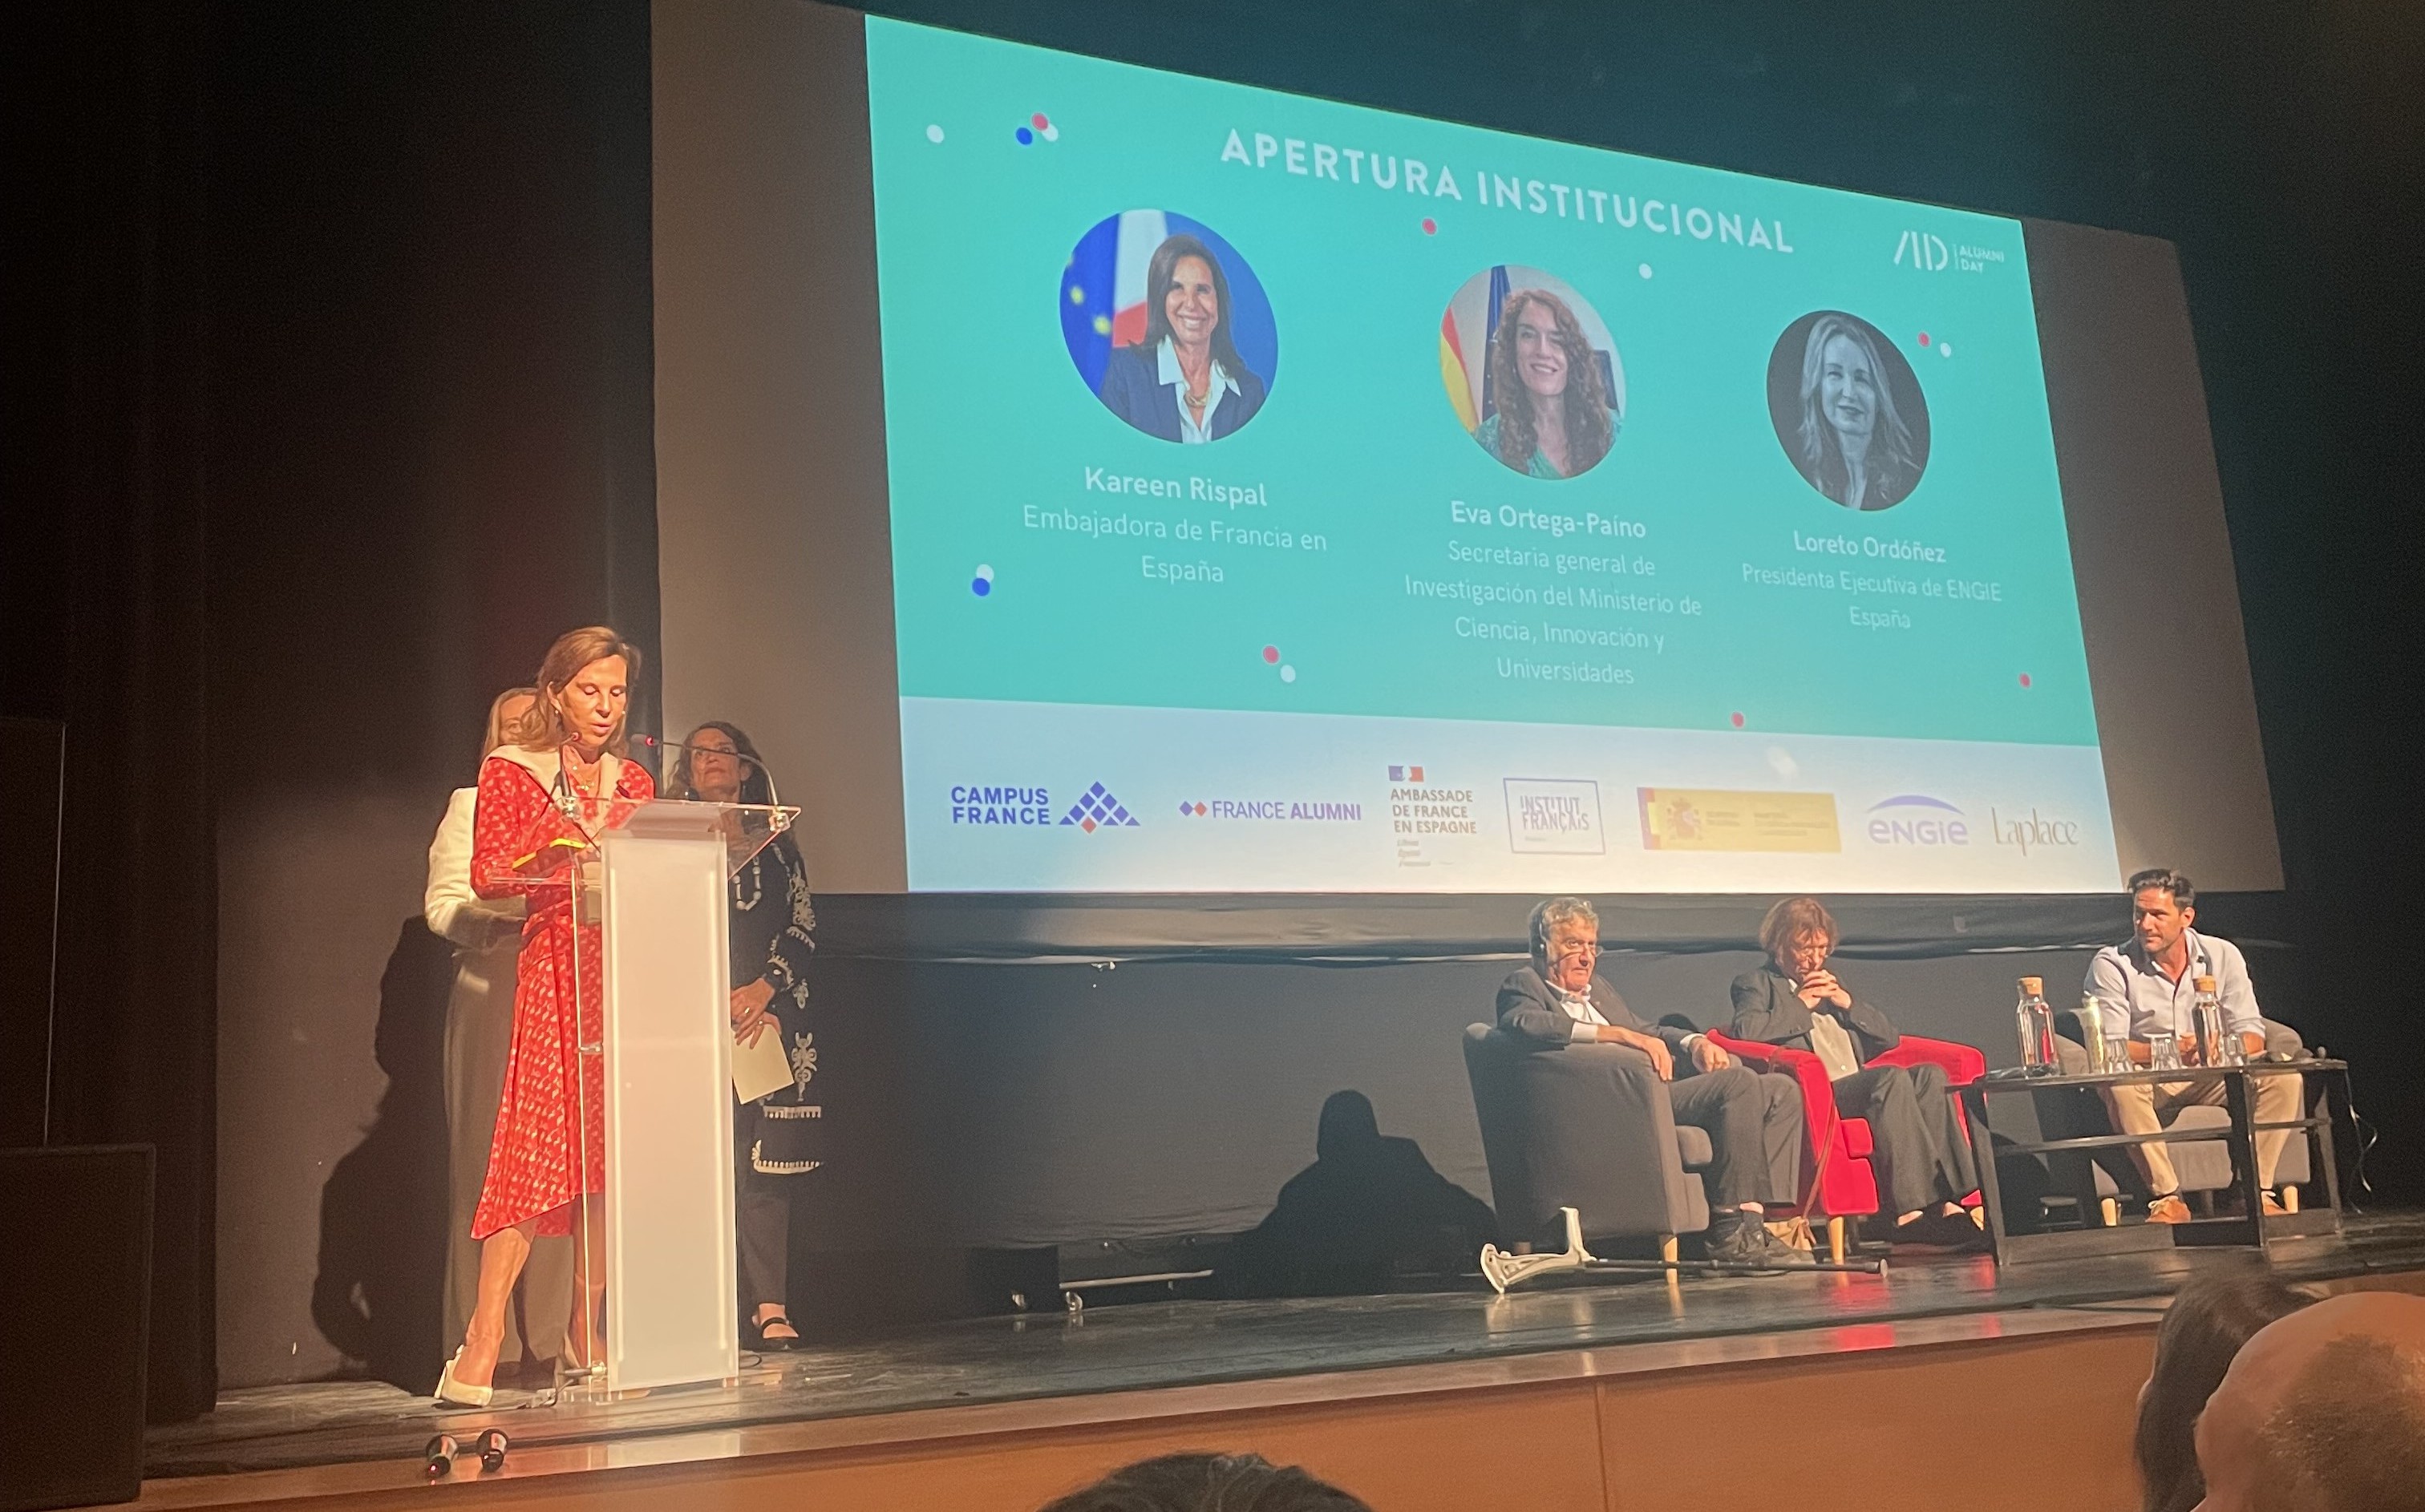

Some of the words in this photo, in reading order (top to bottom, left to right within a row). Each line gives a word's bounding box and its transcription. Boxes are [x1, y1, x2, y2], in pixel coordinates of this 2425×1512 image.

[1220, 128, 1463, 200] APERTURA
[1477, 172, 1794, 253] INSTITUCIONAL
[1960, 245, 2004, 263] ALUMNI
[1961, 258, 1983, 273] DAY
[1085, 466, 1181, 499] Kareen
[1190, 476, 1267, 510] Rispal
[1451, 500, 1492, 525] Eva
[1023, 504, 1167, 539] Embajadora
[1176, 519, 1203, 541] de
[1211, 520, 1293, 548] Francia
[1301, 534, 1327, 552] en
[1448, 540, 1549, 568] Secretaria
[1556, 553, 1626, 575] general
[1633, 556, 1656, 576] de
[1793, 529, 1858, 556] Loreto
[1863, 536, 1946, 563] Ordóñez
[1141, 556, 1224, 585] España
[1743, 562, 1835, 589] Presidenta
[1839, 571, 1917, 596] Ejecutiva
[1922, 577, 1942, 597] de
[1946, 579, 2002, 602] ENGIE
[1406, 574, 1537, 605] Investigación
[1543, 585, 1573, 607] del
[1579, 588, 1674, 614] Ministerio
[1680, 596, 1702, 616] de
[1849, 605, 1910, 631] España
[1455, 617, 1537, 645] Ciencia,
[1544, 621, 1649, 649] Innovación
[1654, 633, 1664, 654] y
[1496, 657, 1634, 685] Universidades
[951, 786, 1049, 806] CAMPUS
[1391, 788, 1473, 802] AMBASSADE
[1520, 795, 1579, 815] INSTITUT
[952, 807, 1051, 825] FRANCE
[1212, 801, 1285, 819] FRANCE
[1290, 802, 1362, 821] ALUMNI
[1392, 804, 1410, 818] DE
[1415, 805, 1468, 819] FRANCE
[1394, 820, 1412, 833] EN
[1416, 820, 1477, 835] ESPAGNE
